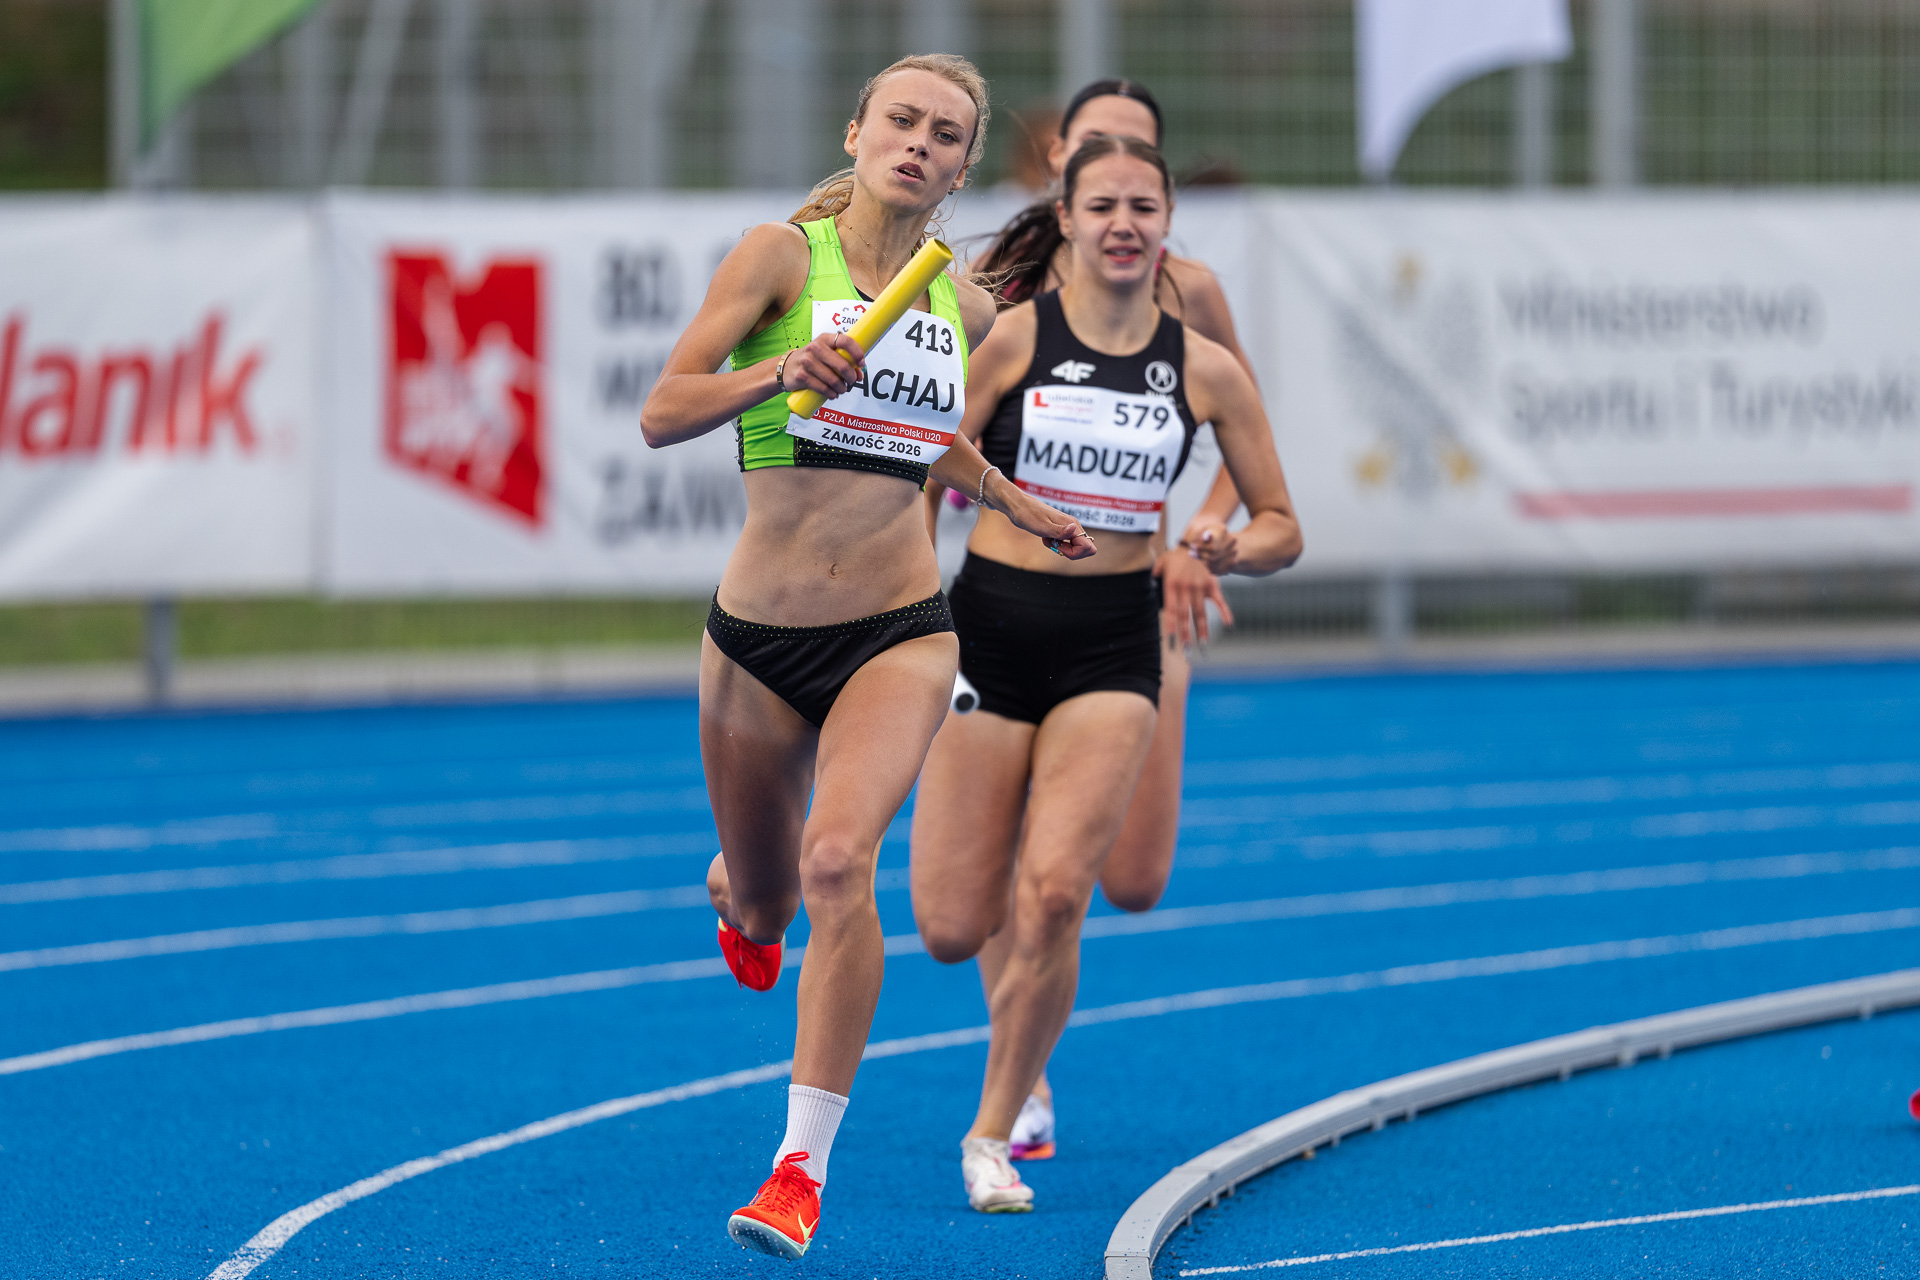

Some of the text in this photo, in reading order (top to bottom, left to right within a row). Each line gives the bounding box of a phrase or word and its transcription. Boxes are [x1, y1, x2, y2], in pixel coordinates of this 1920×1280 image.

[905, 319, 954, 356] 413
[1050, 359, 1097, 384] 4F
[846, 368, 955, 413] ACHAJ
[823, 411, 845, 425] PZLA
[847, 417, 898, 434] Mistrzostwa
[899, 426, 924, 439] Polski
[924, 432, 942, 442] U20
[1113, 401, 1170, 432] 579
[821, 427, 885, 450] ZAMOŚĆ
[888, 440, 922, 457] 2026
[1024, 437, 1168, 484] MADUZIA
